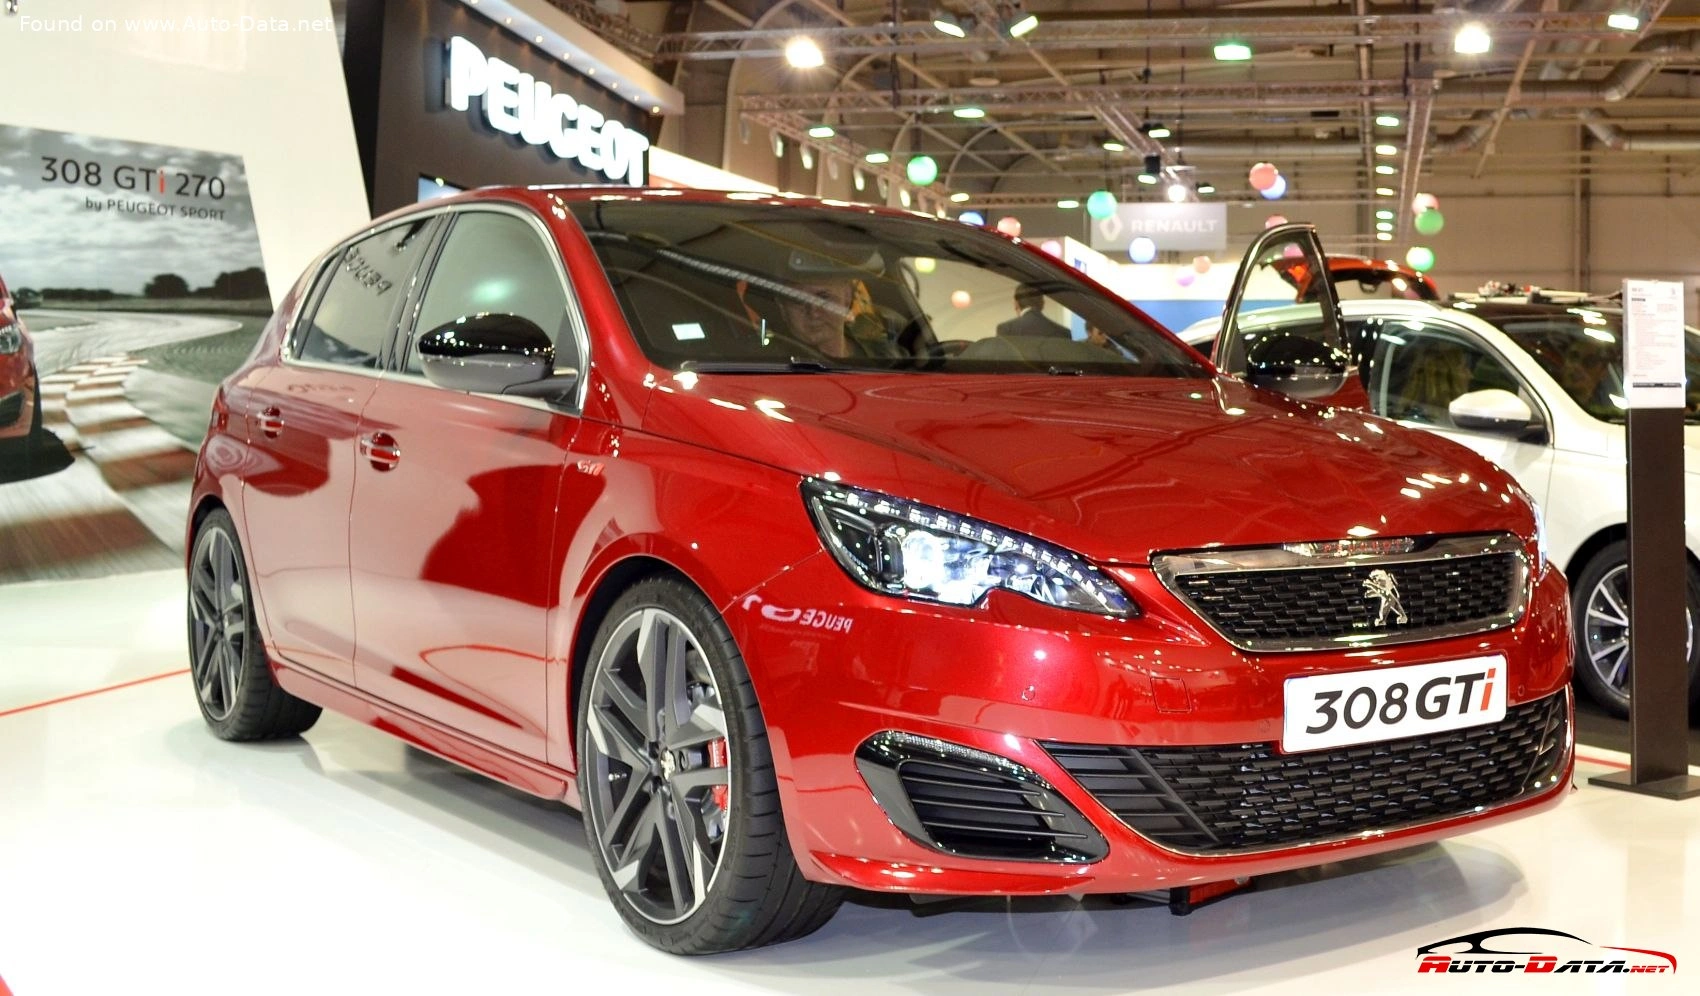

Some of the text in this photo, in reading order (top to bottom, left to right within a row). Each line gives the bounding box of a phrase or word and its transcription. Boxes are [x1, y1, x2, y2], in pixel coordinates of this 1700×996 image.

[451, 36, 649, 187] PEUGEOT
[41, 156, 226, 201] 308 GTi 270
[86, 197, 226, 221] by PEUGEOT SPORT
[1131, 219, 1217, 233] RENAULT
